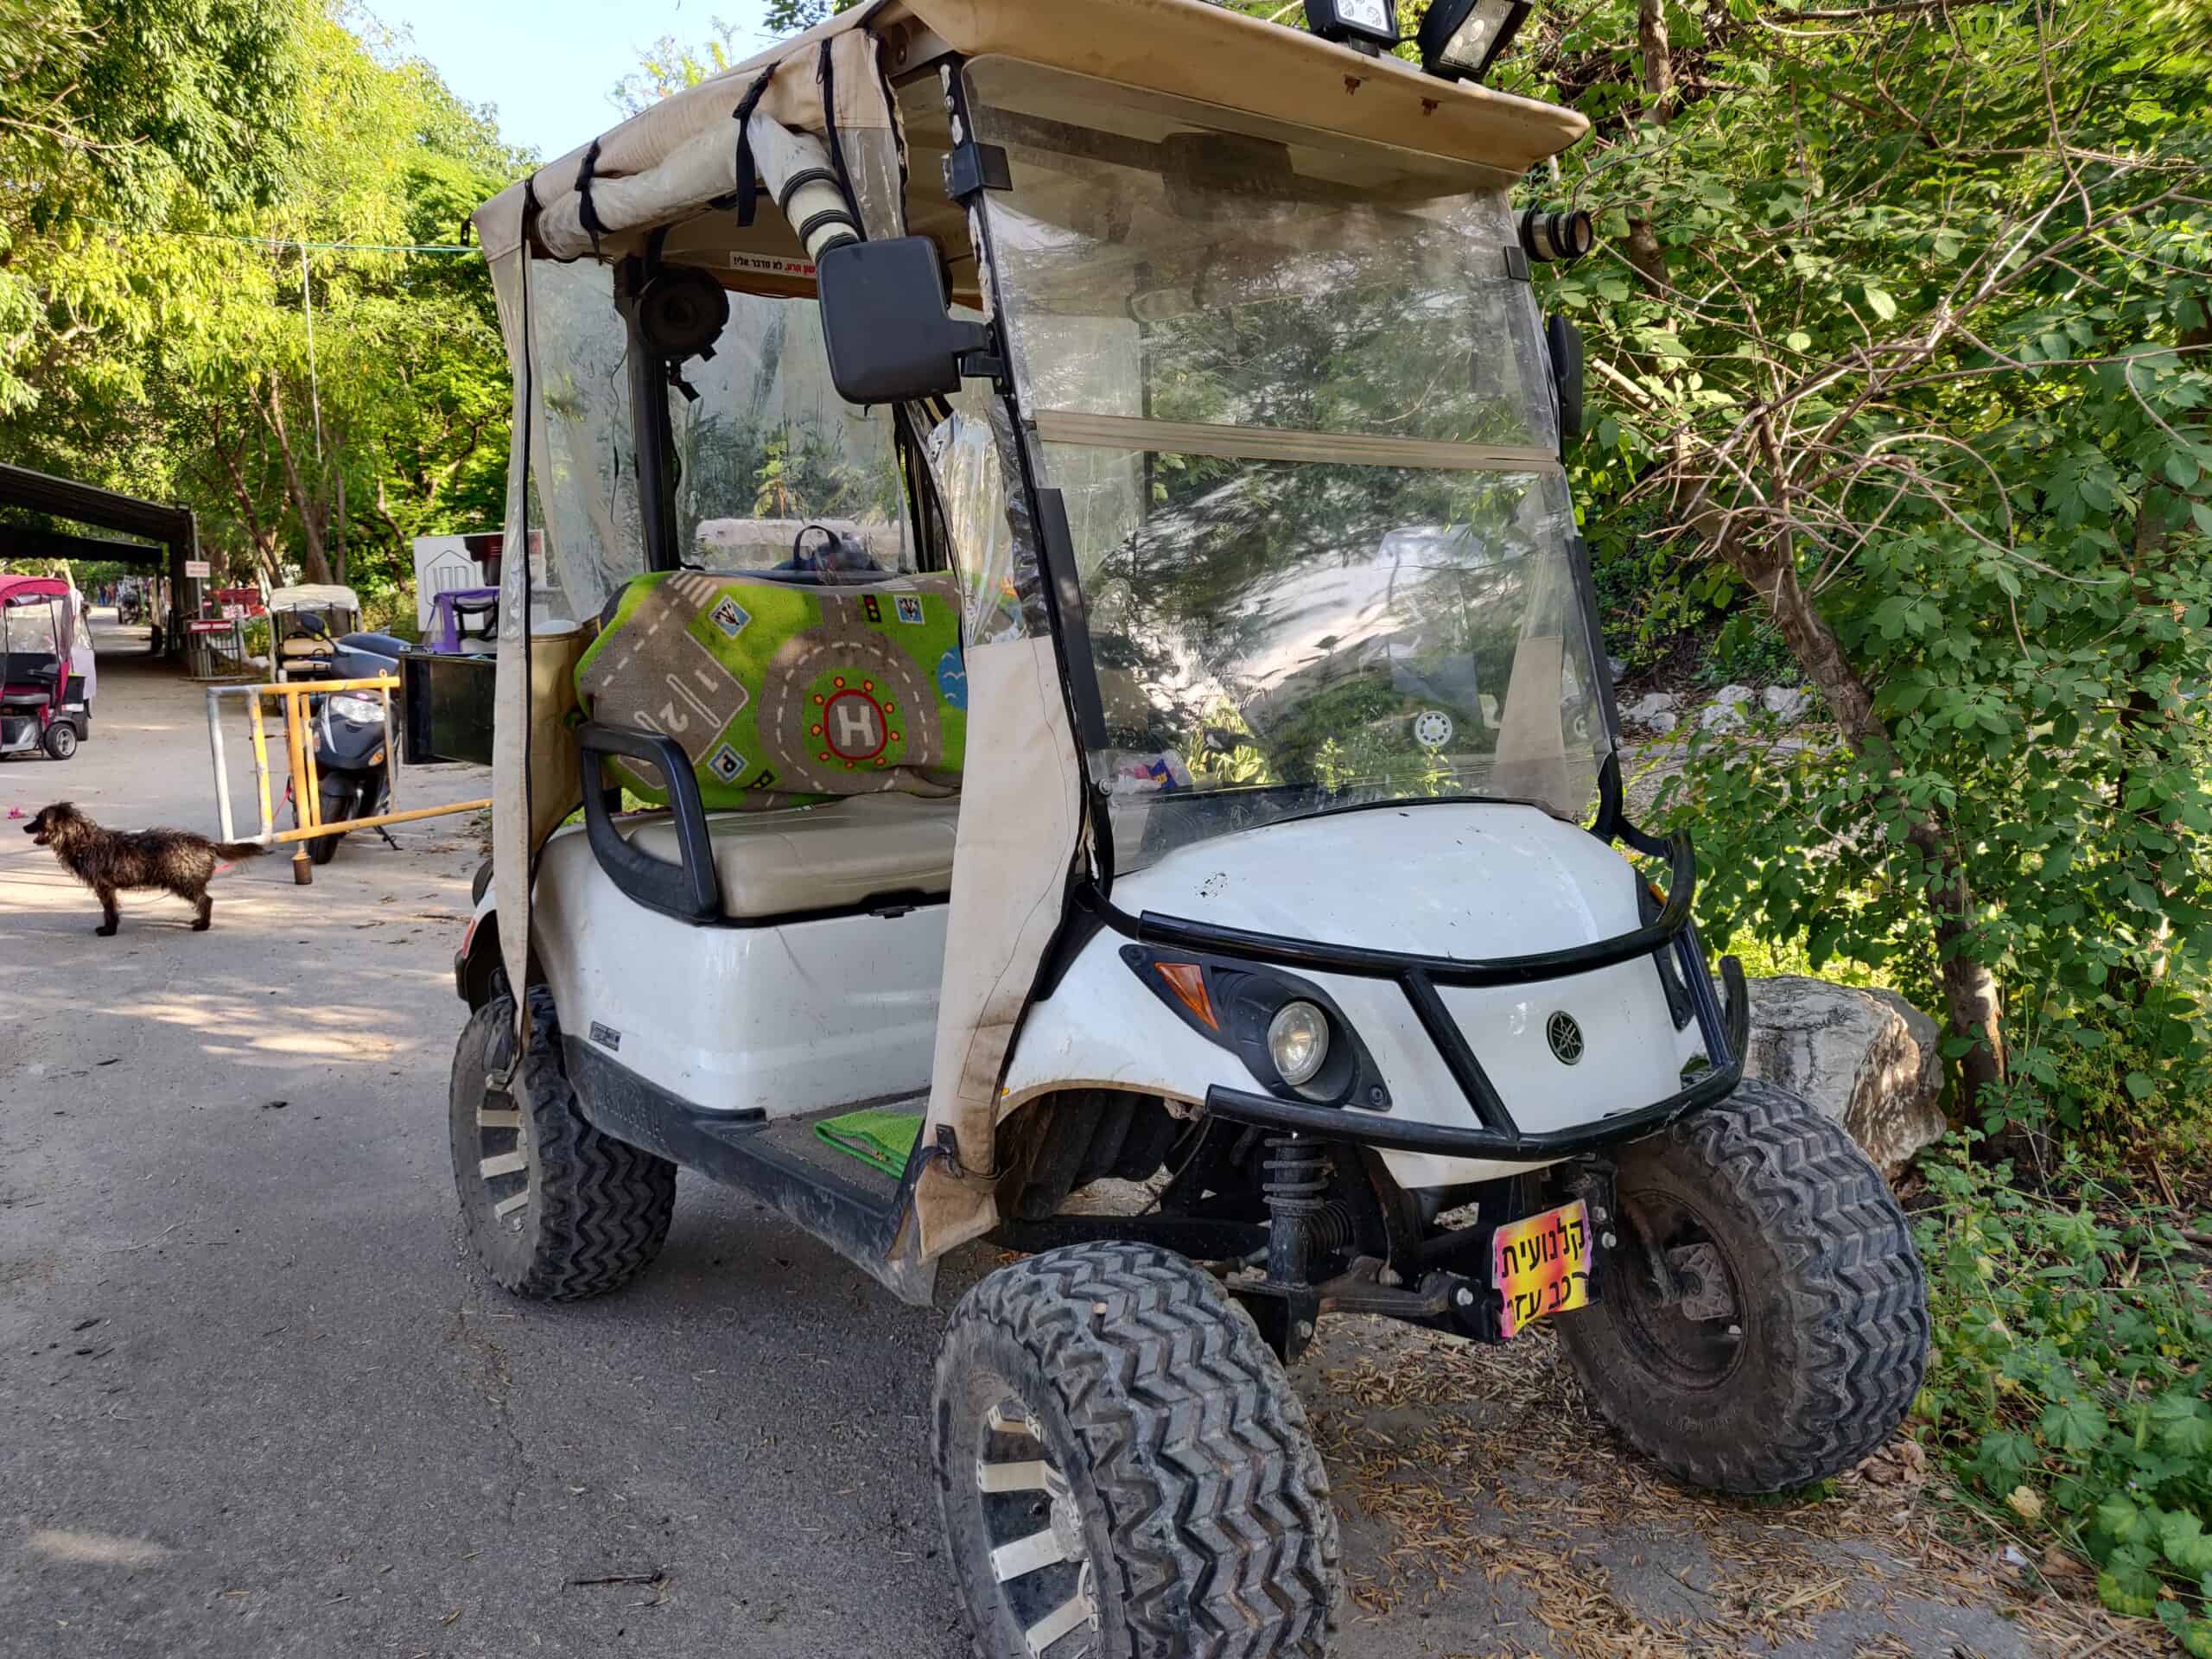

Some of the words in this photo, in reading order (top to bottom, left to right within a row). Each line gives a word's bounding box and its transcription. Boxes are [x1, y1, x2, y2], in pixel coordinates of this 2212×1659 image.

[752, 258, 771, 269] מדבר
[772, 261, 782, 270] לא
[836, 705, 876, 747] H
[1501, 1217, 1585, 1279] קלנועית
[1548, 1271, 1589, 1310] רכב
